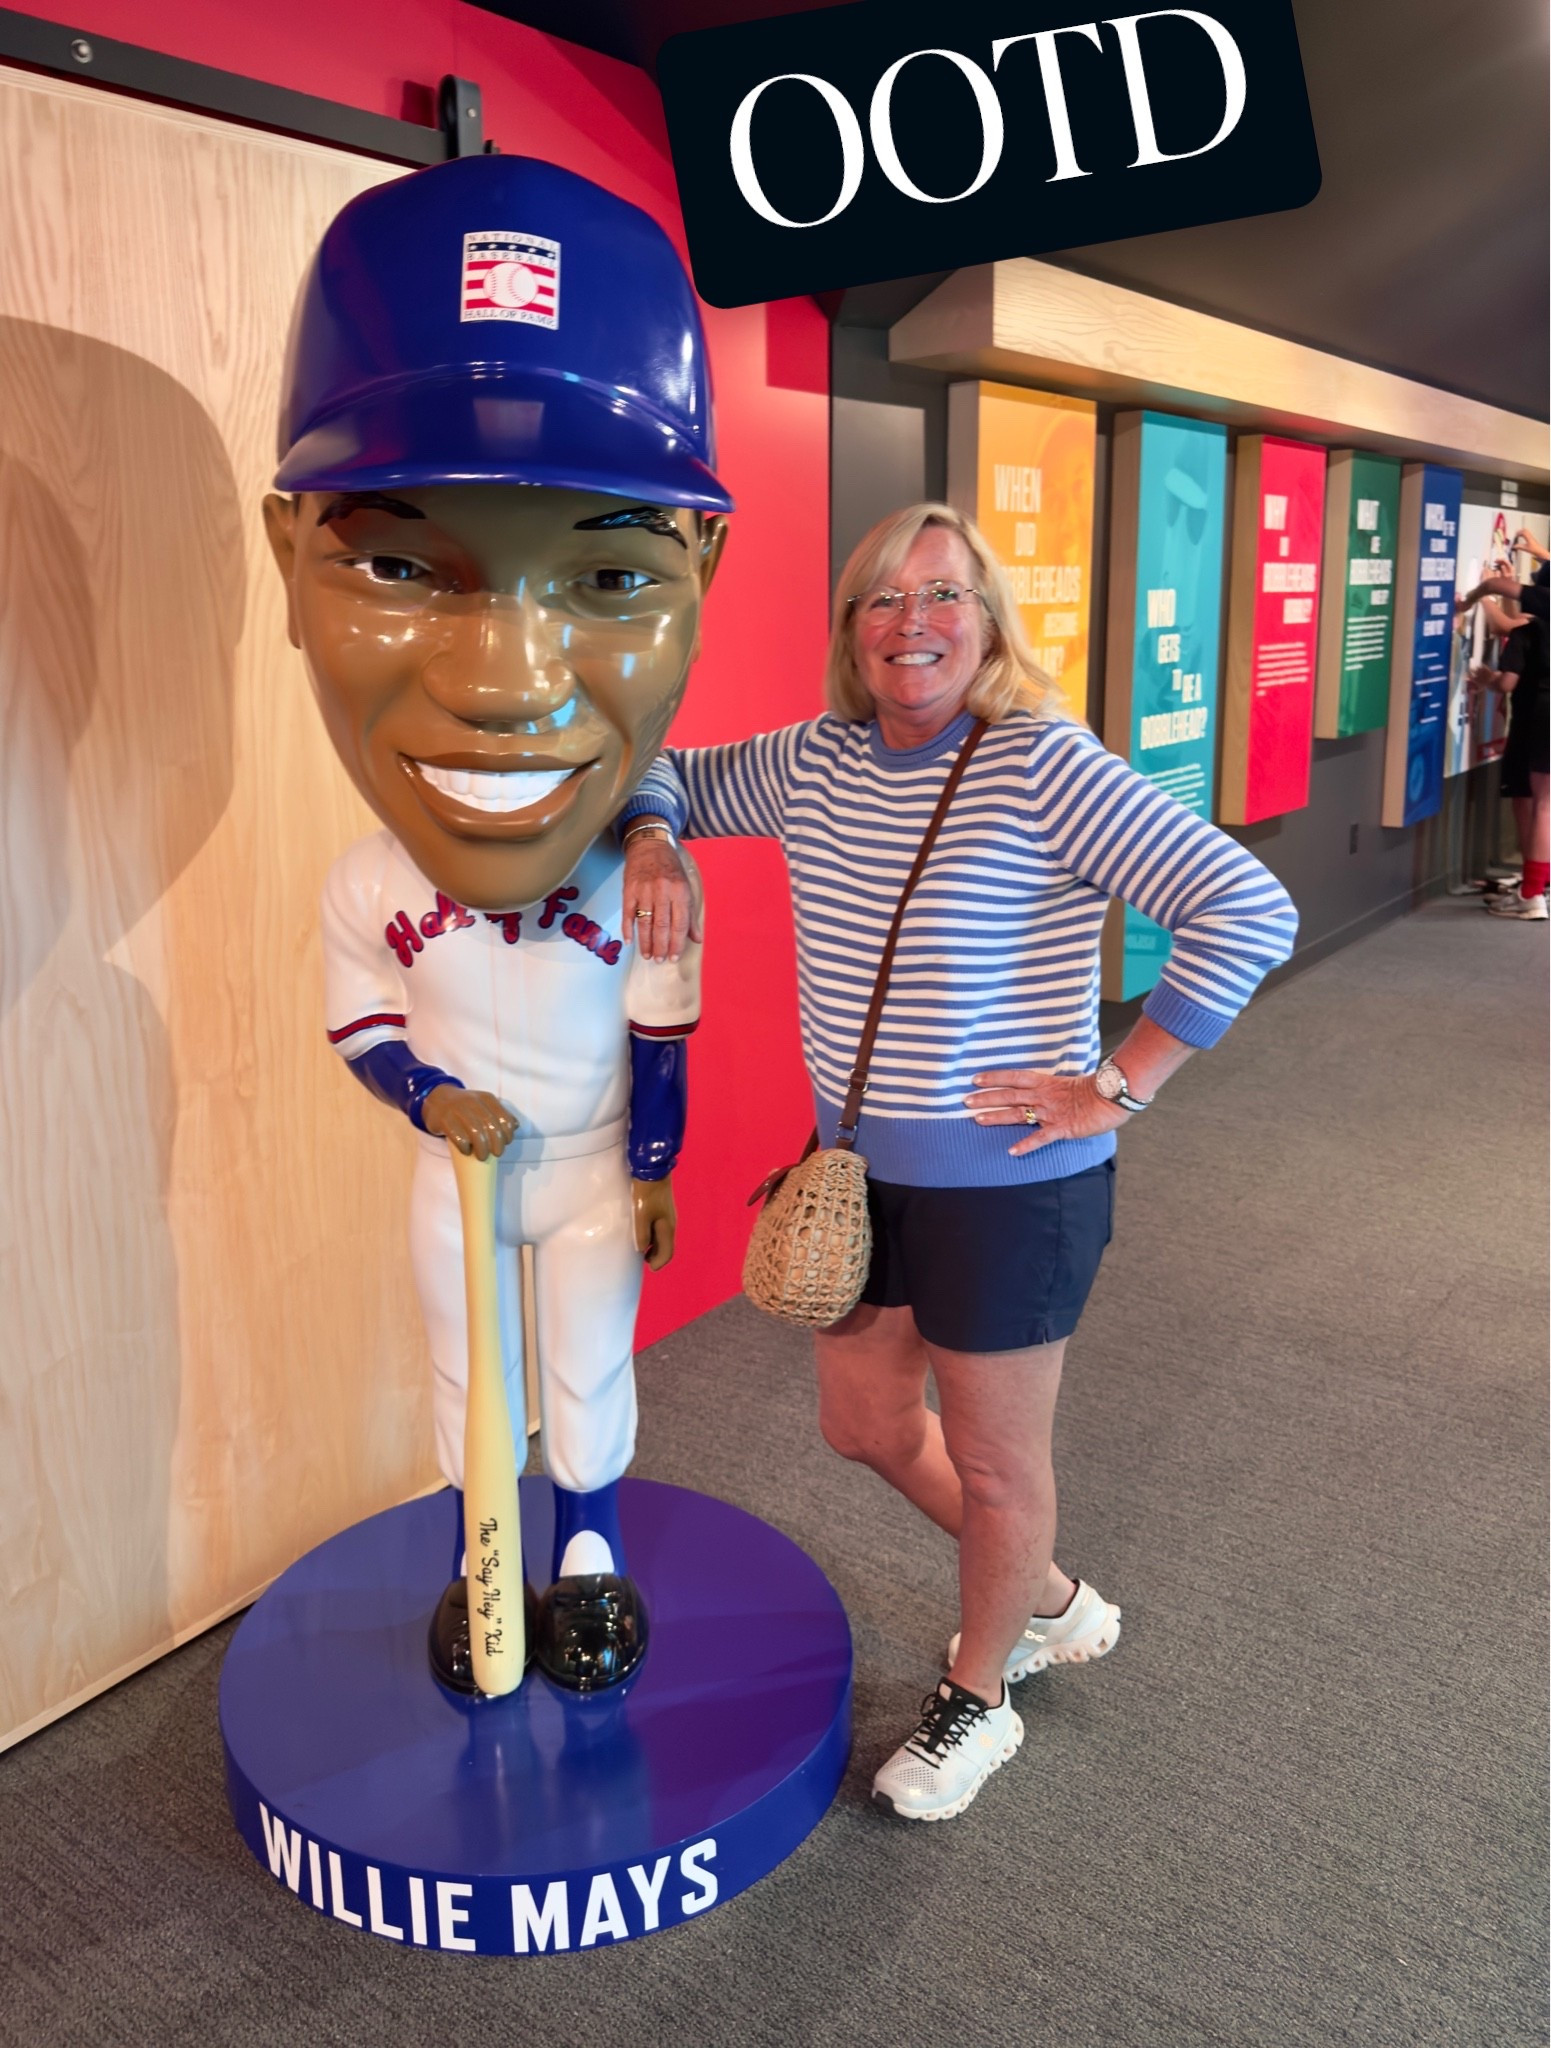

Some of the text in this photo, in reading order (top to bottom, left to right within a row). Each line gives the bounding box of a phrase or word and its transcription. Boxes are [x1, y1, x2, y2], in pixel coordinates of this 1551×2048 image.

[468, 233, 556, 250] NATIONAL
[464, 308, 497, 319] HALL
[994, 464, 1042, 513] WHEN
[538, 886, 622, 965] Fame
[479, 1517, 498, 1547] The
[484, 1628, 504, 1657] Kid
[259, 1801, 719, 1953] WILLIE MAYS
